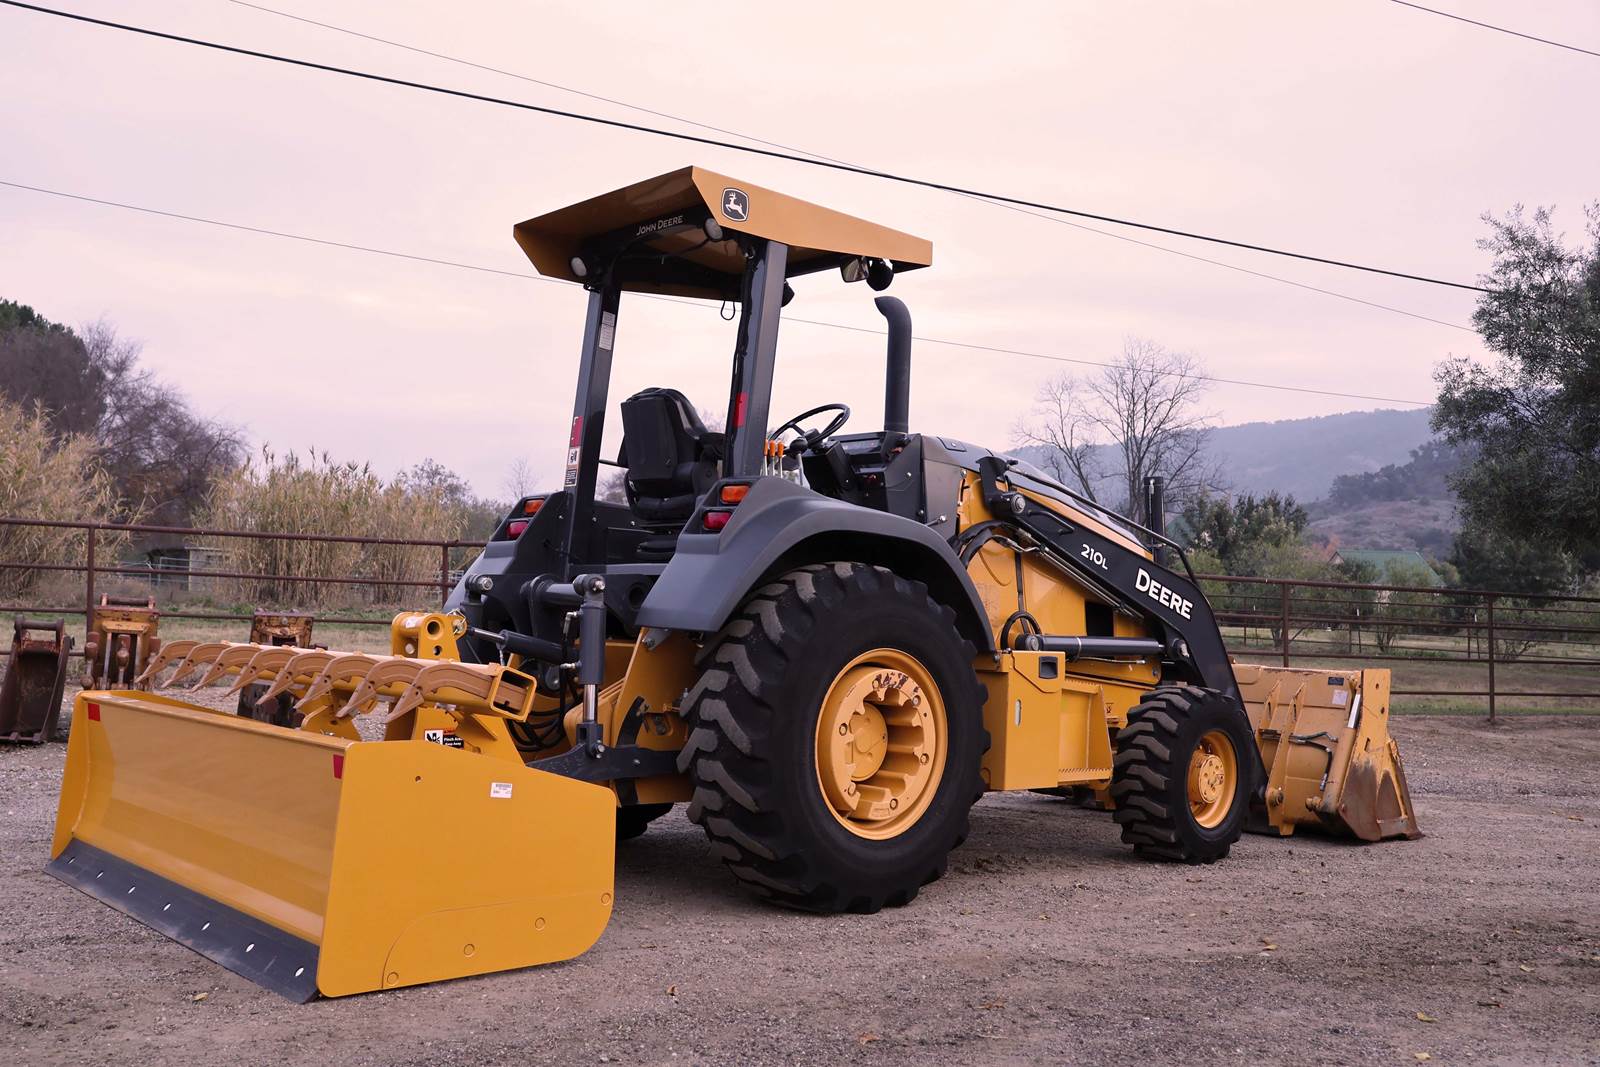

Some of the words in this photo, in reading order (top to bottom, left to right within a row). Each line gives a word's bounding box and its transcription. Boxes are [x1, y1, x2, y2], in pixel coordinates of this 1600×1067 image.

[636, 223, 657, 236] JOHN
[657, 216, 683, 229] DEERE
[1081, 544, 1108, 570] 210L
[1135, 568, 1193, 619] DEERE
